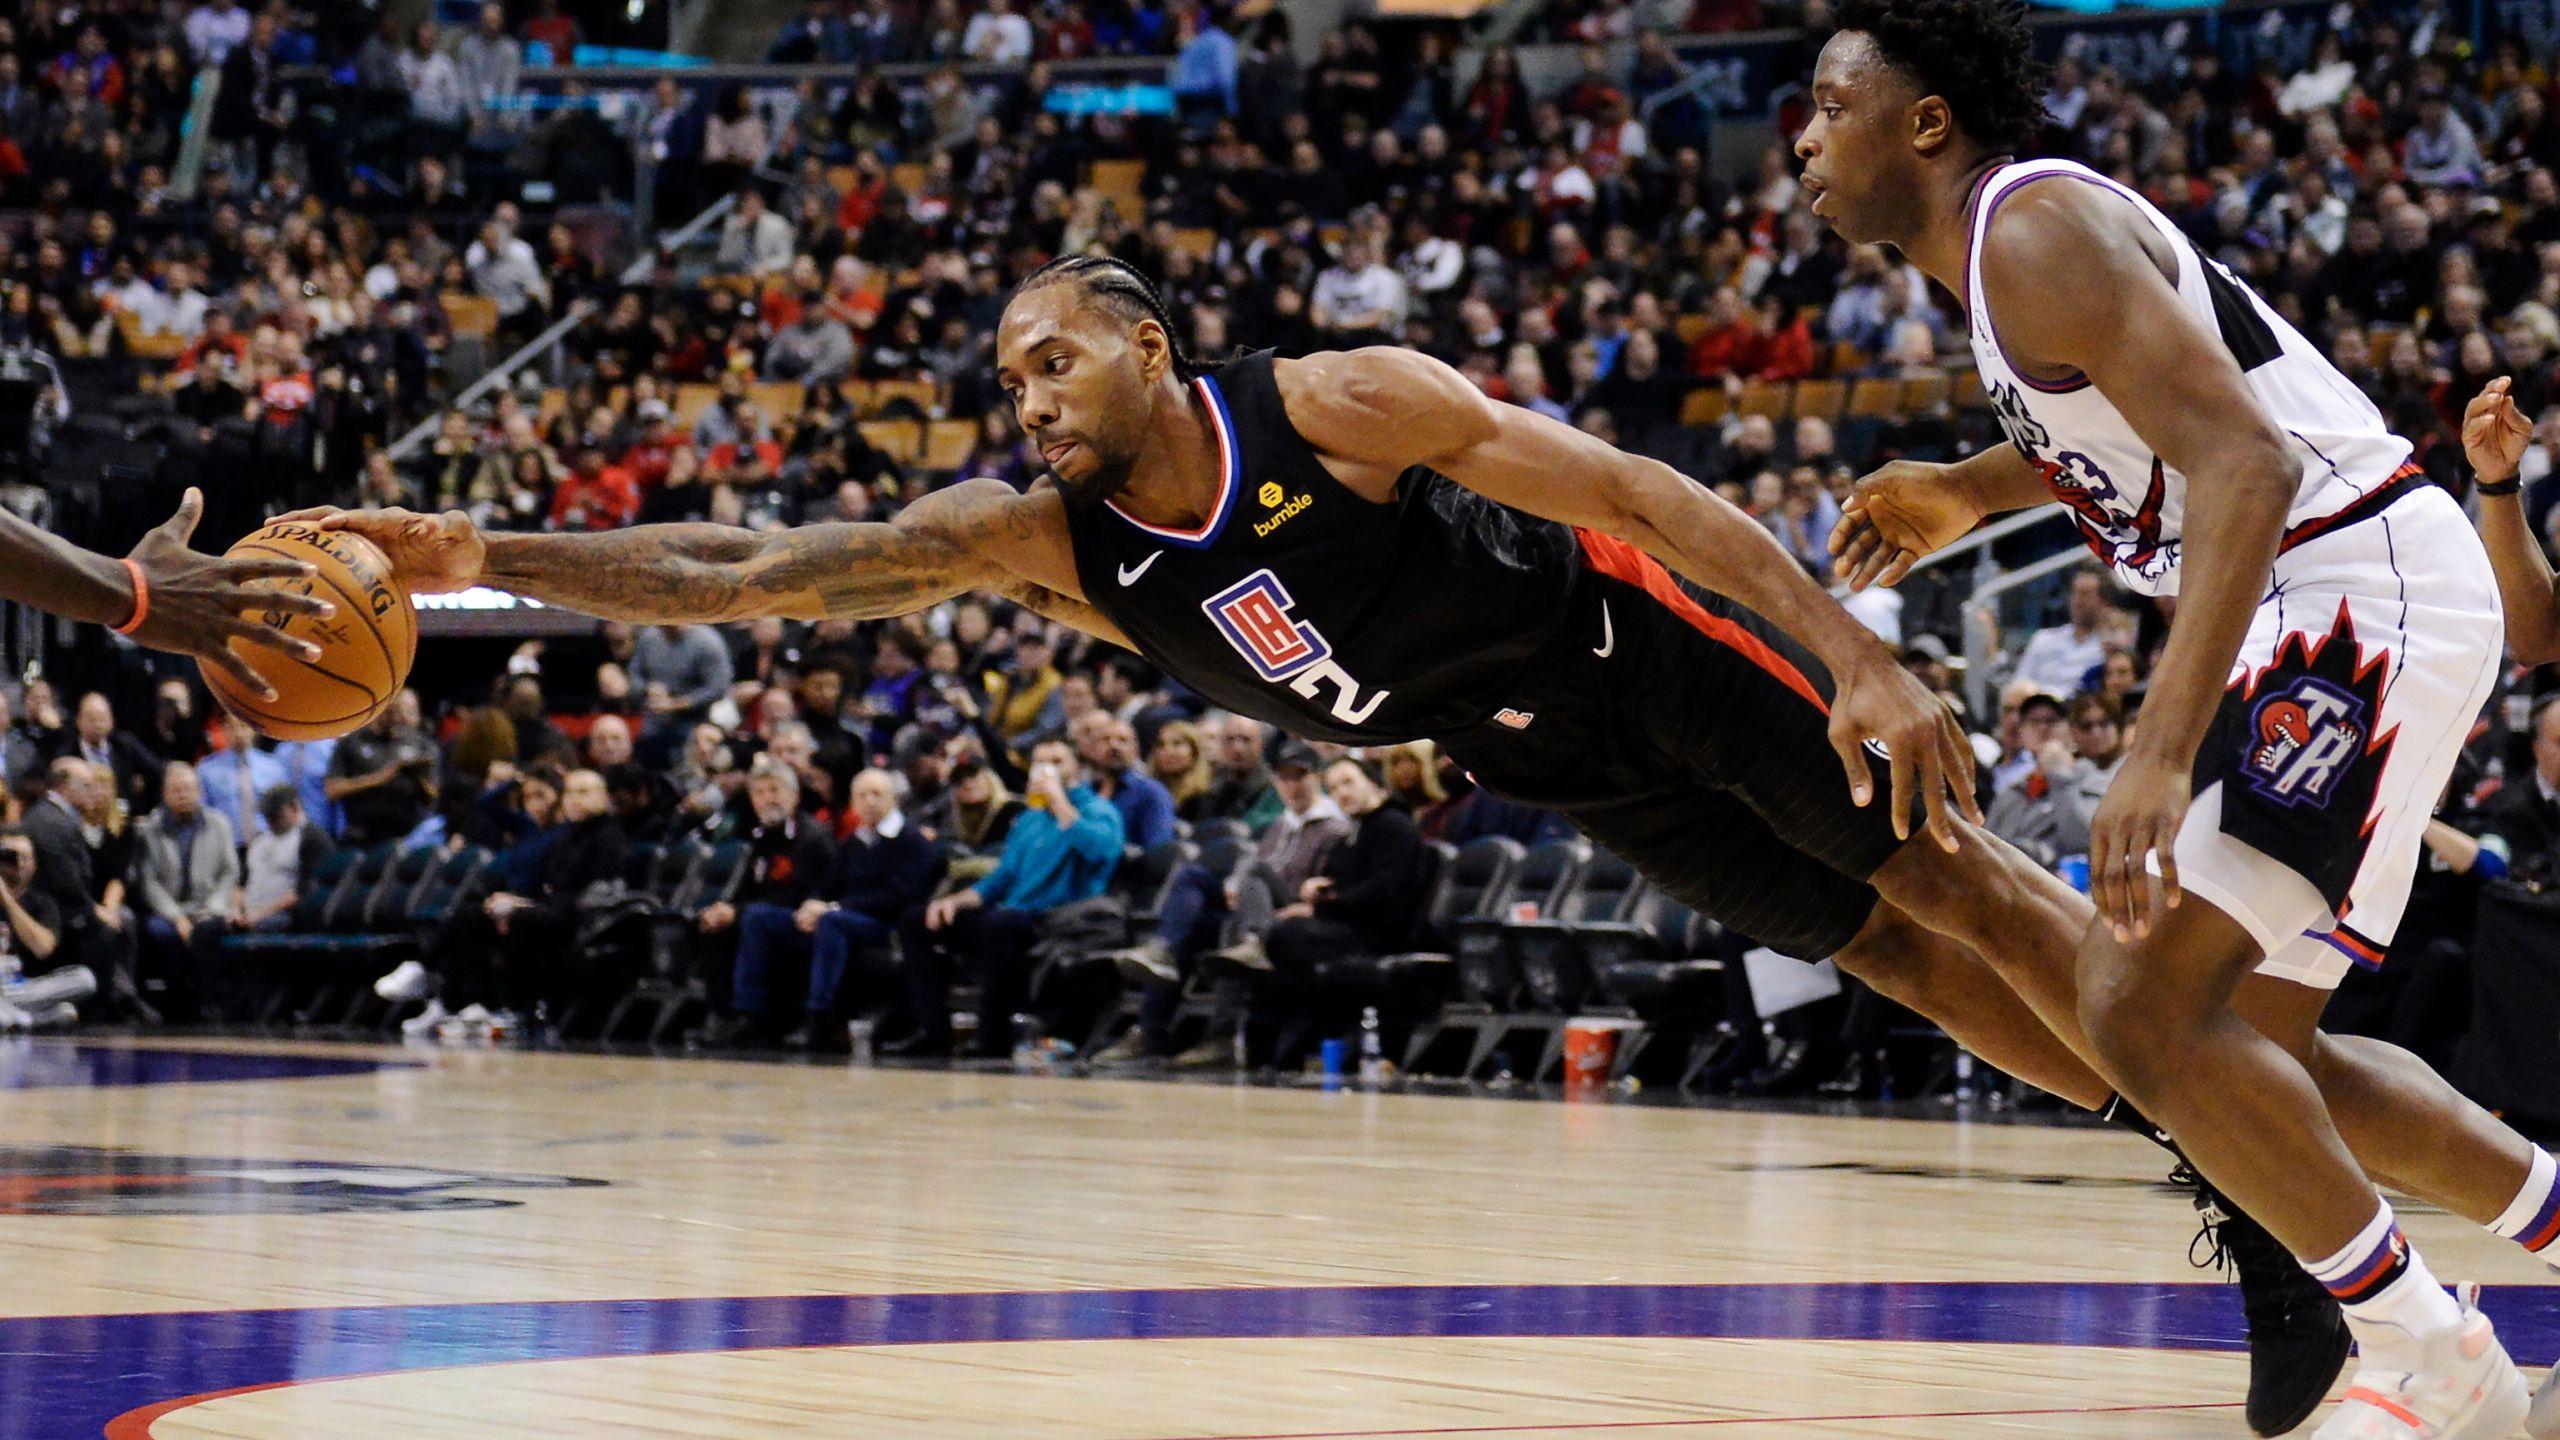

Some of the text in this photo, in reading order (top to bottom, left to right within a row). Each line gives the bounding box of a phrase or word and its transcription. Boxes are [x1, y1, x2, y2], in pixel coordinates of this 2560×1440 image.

[1253, 494, 1313, 538] bumble
[260, 525, 395, 617] SPALDING
[1289, 659, 1391, 725] 2
